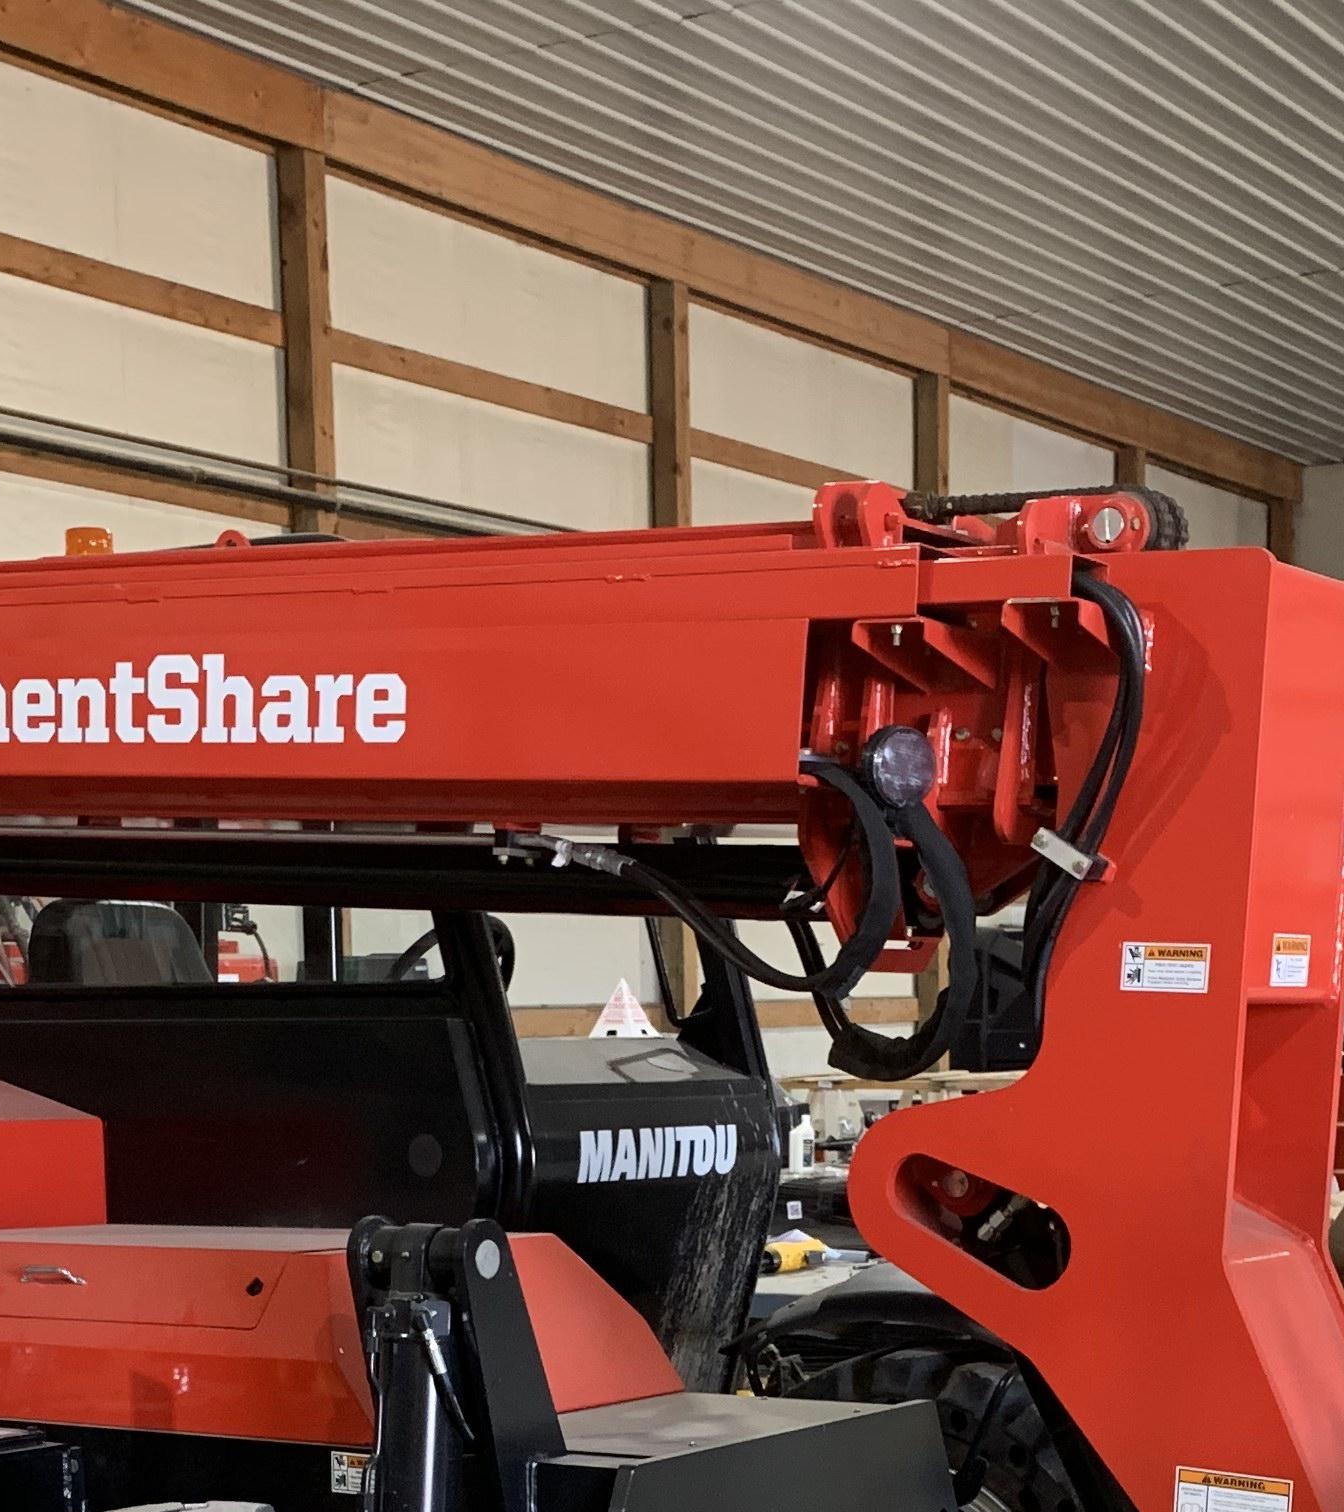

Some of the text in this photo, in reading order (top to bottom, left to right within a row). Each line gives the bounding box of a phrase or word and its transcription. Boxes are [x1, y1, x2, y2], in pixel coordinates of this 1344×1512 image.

[1157, 948, 1204, 959] WARNING
[576, 1123, 738, 1185] MANITOU
[1213, 1476, 1266, 1490] WARNING
